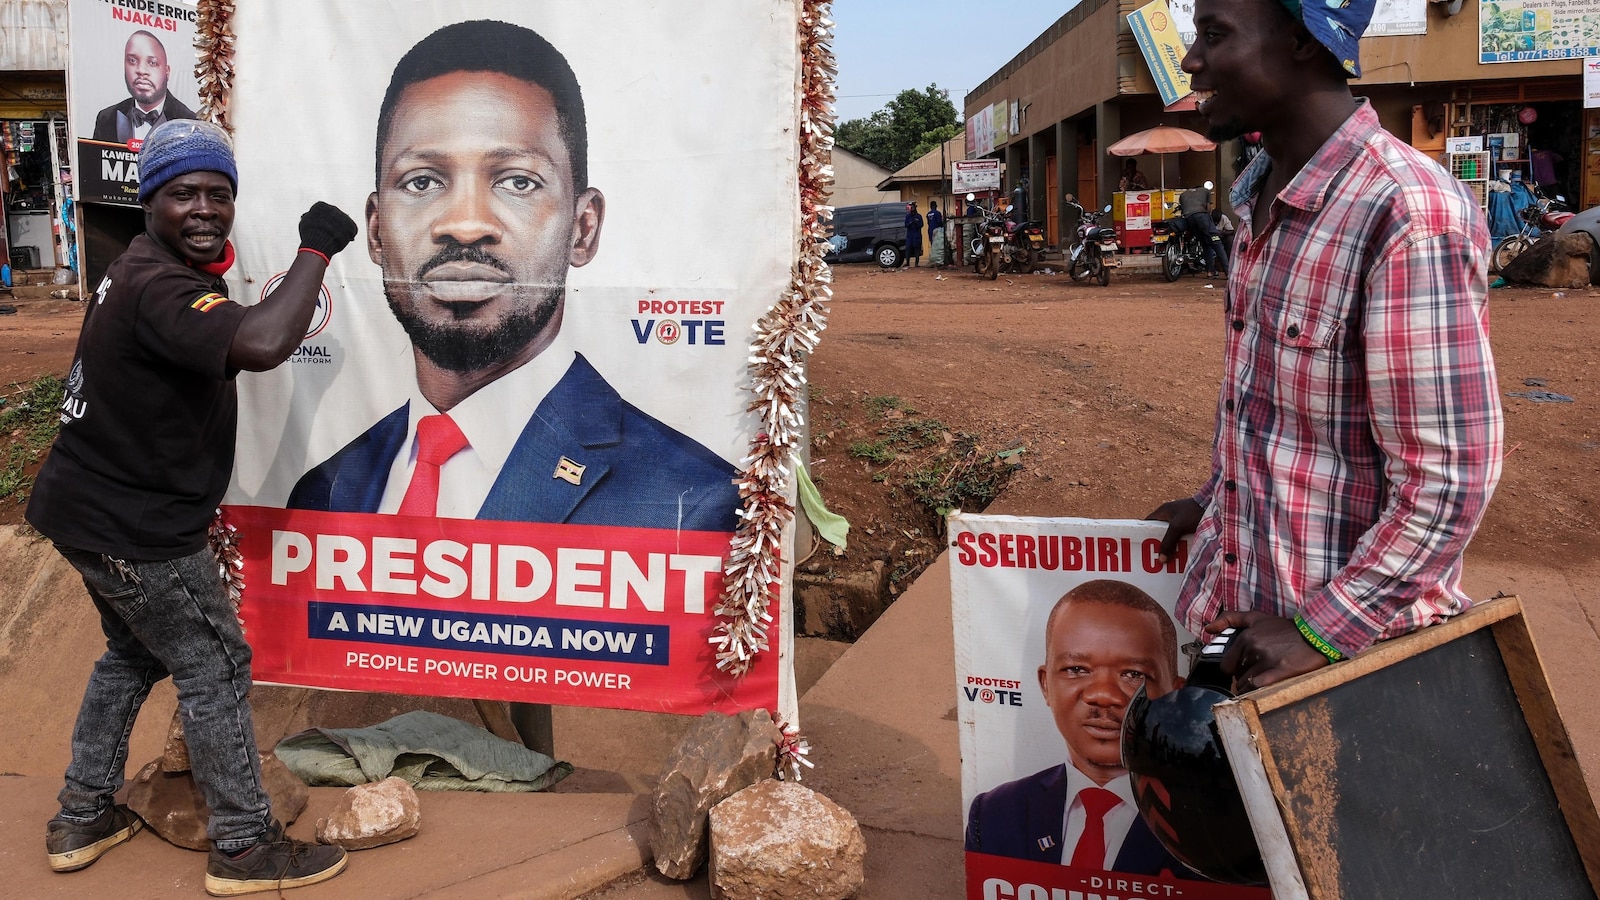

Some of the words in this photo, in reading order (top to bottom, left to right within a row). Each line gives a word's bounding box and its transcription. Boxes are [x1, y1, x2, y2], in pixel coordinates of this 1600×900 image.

[112, 6, 177, 32] NJAKASI
[158, 4, 199, 22] ERRIC
[1133, 14, 1150, 46] MOTORCYCLE
[1153, 62, 1165, 82] GARAGE
[1163, 82, 1173, 100] CENTRE
[1164, 44, 1189, 86] ADVANCE
[1496, 53, 1514, 61] Tel:
[1518, 49, 1566, 60] 0771-896
[638, 300, 725, 315] PROTEST
[630, 318, 726, 346] VOTE
[956, 531, 1132, 573] SSERUBIRI
[271, 530, 722, 614] PRESIDENT
[327, 611, 350, 632] A
[357, 612, 425, 638] NEW
[432, 618, 554, 649] UGANDA
[562, 628, 638, 654] NOW
[646, 634, 654, 656] !
[346, 652, 419, 673] PEOPLE
[425, 658, 498, 680] POWER
[503, 666, 548, 684] OUR
[554, 669, 632, 690] POWER
[967, 676, 1022, 689] PROTEST
[964, 686, 1023, 707] VOTE
[1080, 876, 1183, 896] -DIRECT-
